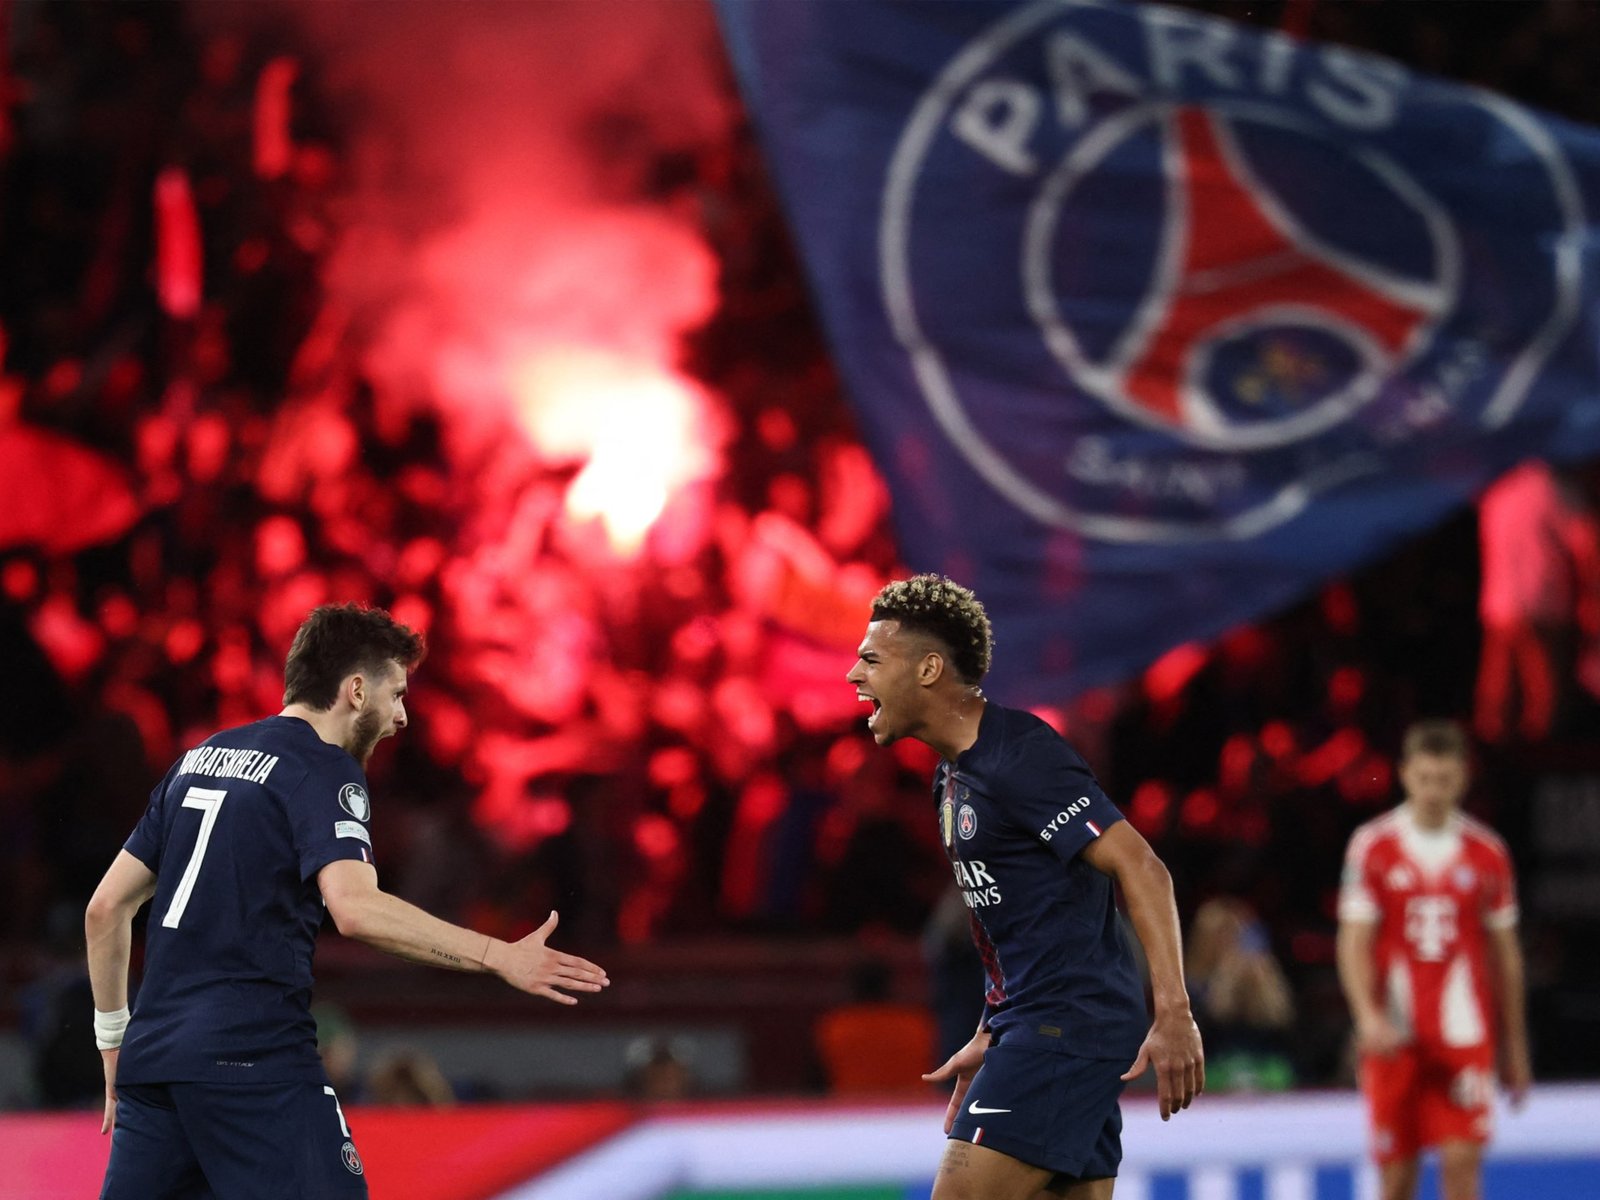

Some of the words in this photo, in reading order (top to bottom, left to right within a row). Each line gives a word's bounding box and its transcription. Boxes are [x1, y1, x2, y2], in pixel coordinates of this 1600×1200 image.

[950, 8, 1409, 177] PARIS
[1040, 796, 1091, 841] EYOND
[161, 787, 228, 929] 7
[961, 886, 1002, 908] WAYS
[323, 1086, 351, 1138] 7
